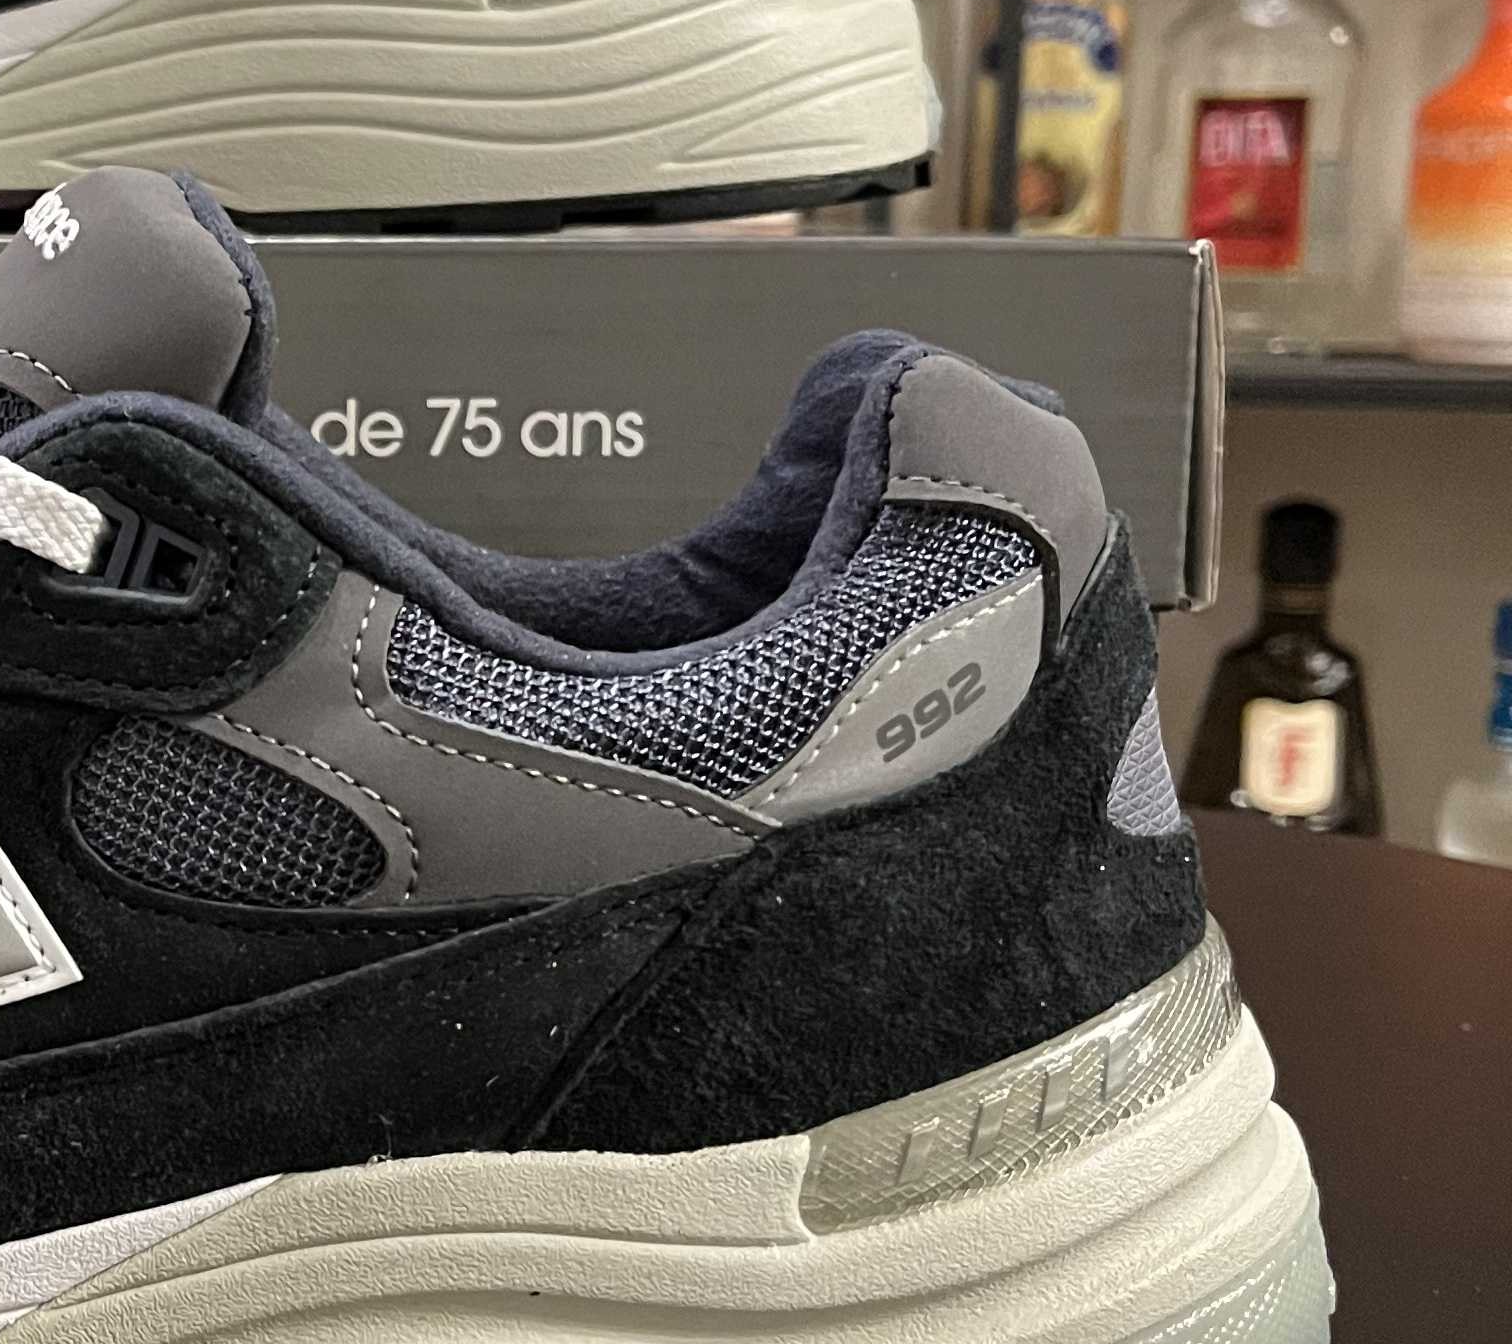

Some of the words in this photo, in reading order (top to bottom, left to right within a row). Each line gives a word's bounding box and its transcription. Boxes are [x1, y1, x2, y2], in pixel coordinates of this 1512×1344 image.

[310, 398, 404, 457] de
[426, 398, 502, 457] 75
[520, 411, 644, 457] ans
[876, 662, 986, 763] 992
